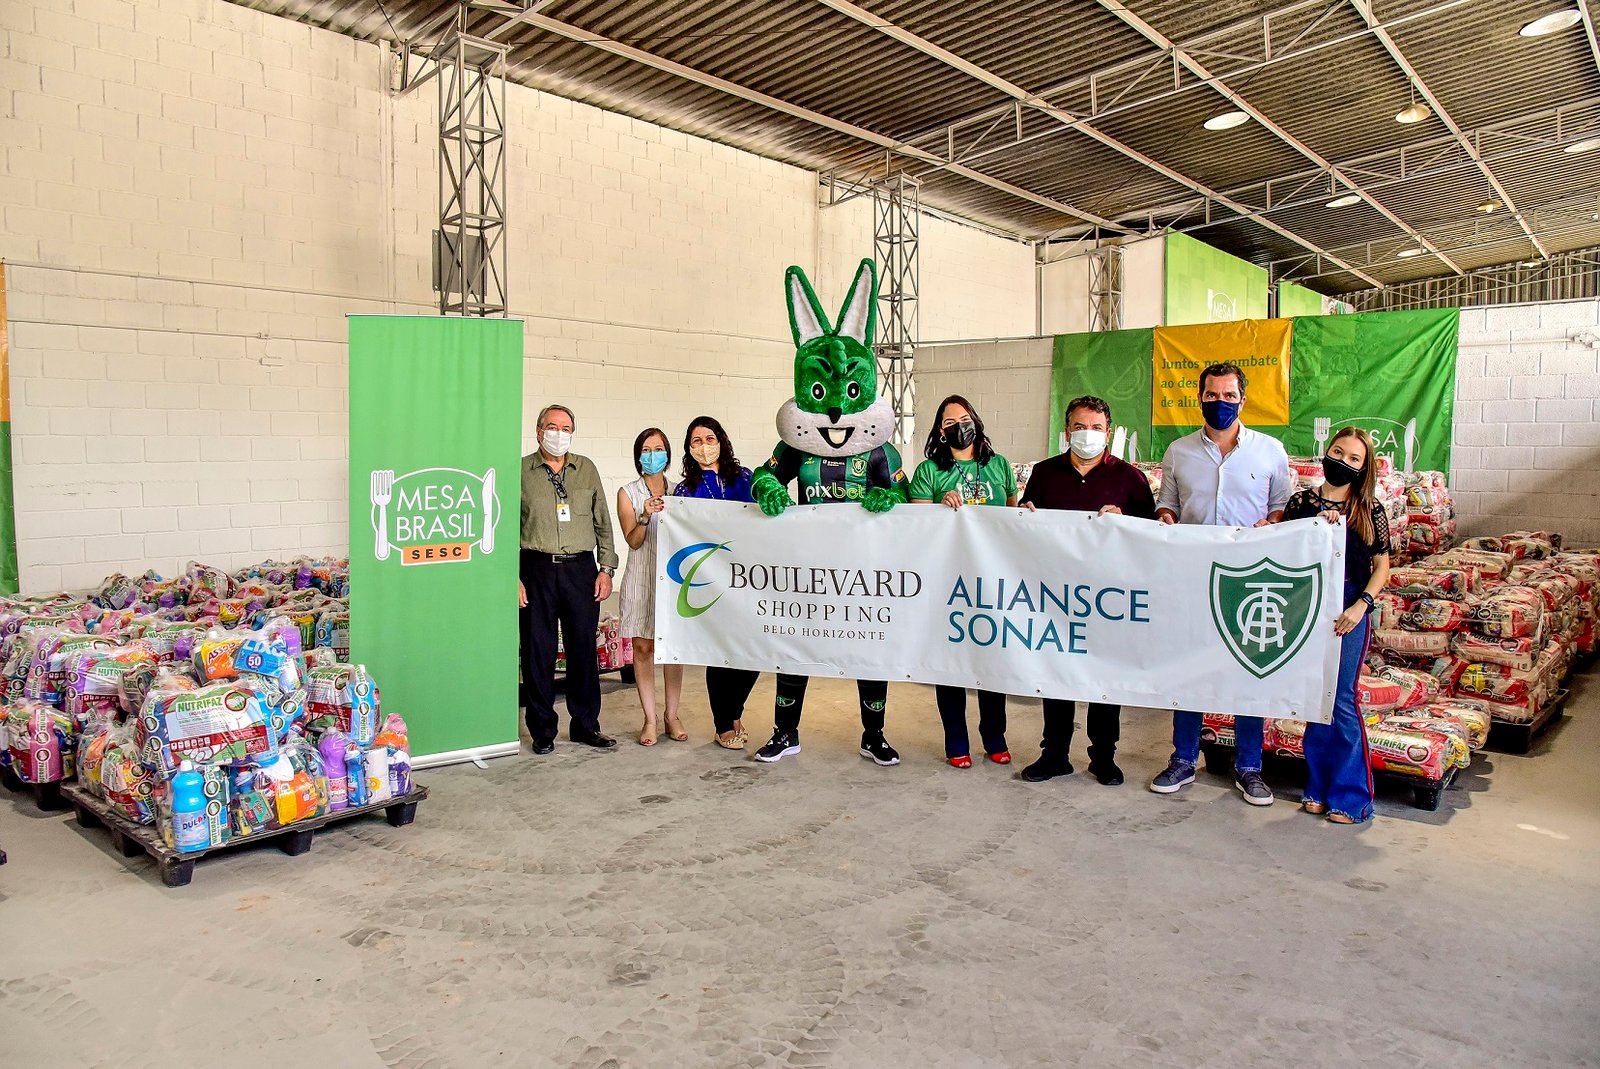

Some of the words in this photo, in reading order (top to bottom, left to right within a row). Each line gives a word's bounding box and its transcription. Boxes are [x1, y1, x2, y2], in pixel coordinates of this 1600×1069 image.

[1161, 358, 1200, 369] Juntos
[1161, 380, 1174, 388] ao
[1161, 396, 1174, 407] de
[397, 484, 476, 512] MESA
[805, 481, 865, 502] pixbet
[397, 513, 476, 541] BRASIL
[411, 546, 462, 560] SESC
[728, 562, 922, 598] BOULEVARD
[946, 574, 1150, 623] ALIANSCE
[757, 599, 892, 623] SHOPPING
[763, 624, 796, 636] BELO
[802, 627, 886, 641] HORIZONTE
[948, 610, 1088, 654] SONAE
[248, 656, 262, 667] 50
[177, 696, 223, 712] NUTRIFAZ
[1367, 736, 1408, 752] NUTRIFAZ
